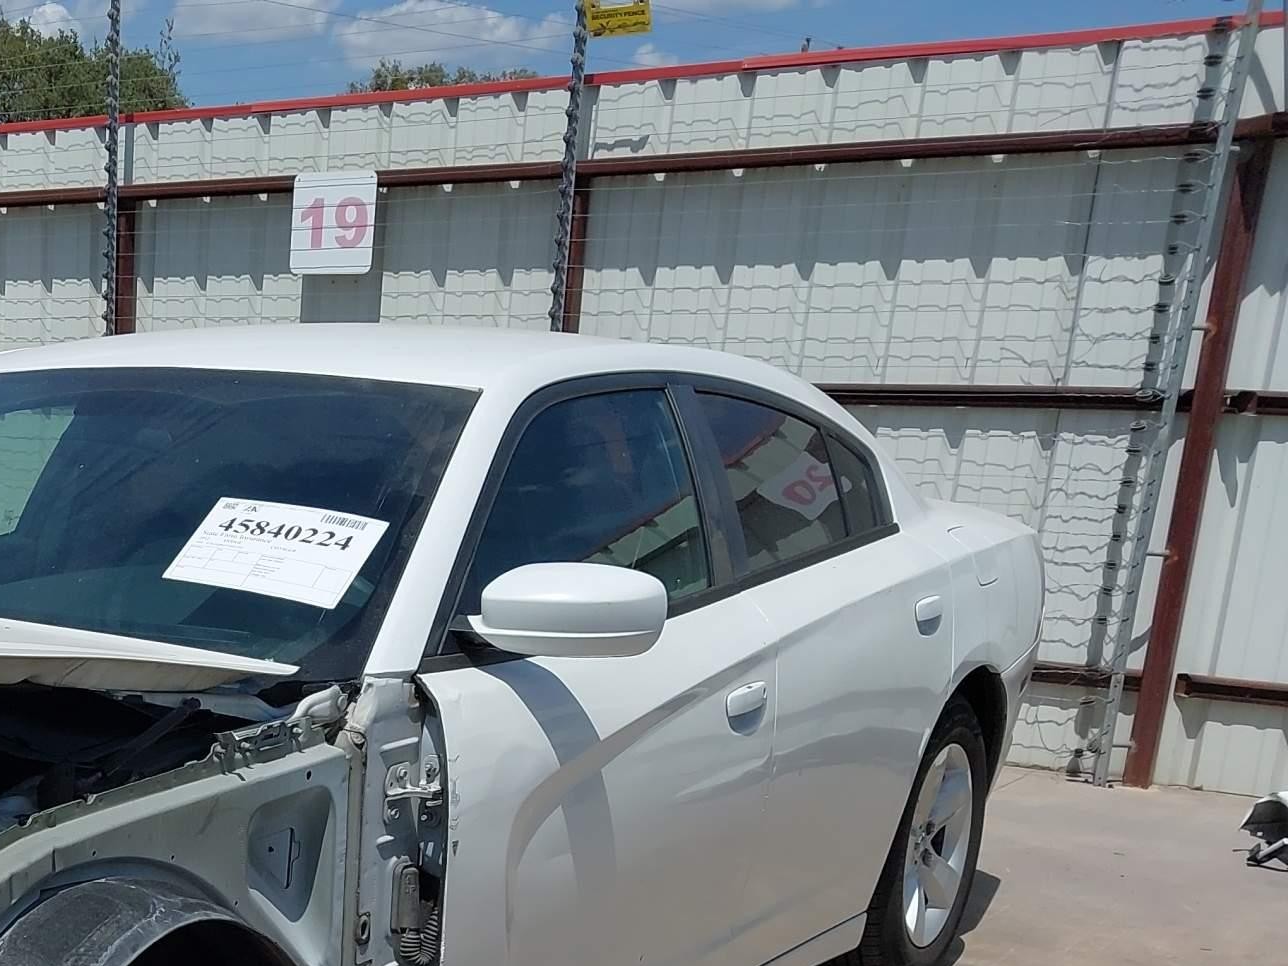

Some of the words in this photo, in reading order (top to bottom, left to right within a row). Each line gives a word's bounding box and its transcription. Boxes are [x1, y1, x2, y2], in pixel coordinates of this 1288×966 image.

[592, 12, 623, 20] SECURITY
[301, 197, 368, 248] 19
[218, 517, 354, 551] 45840224
